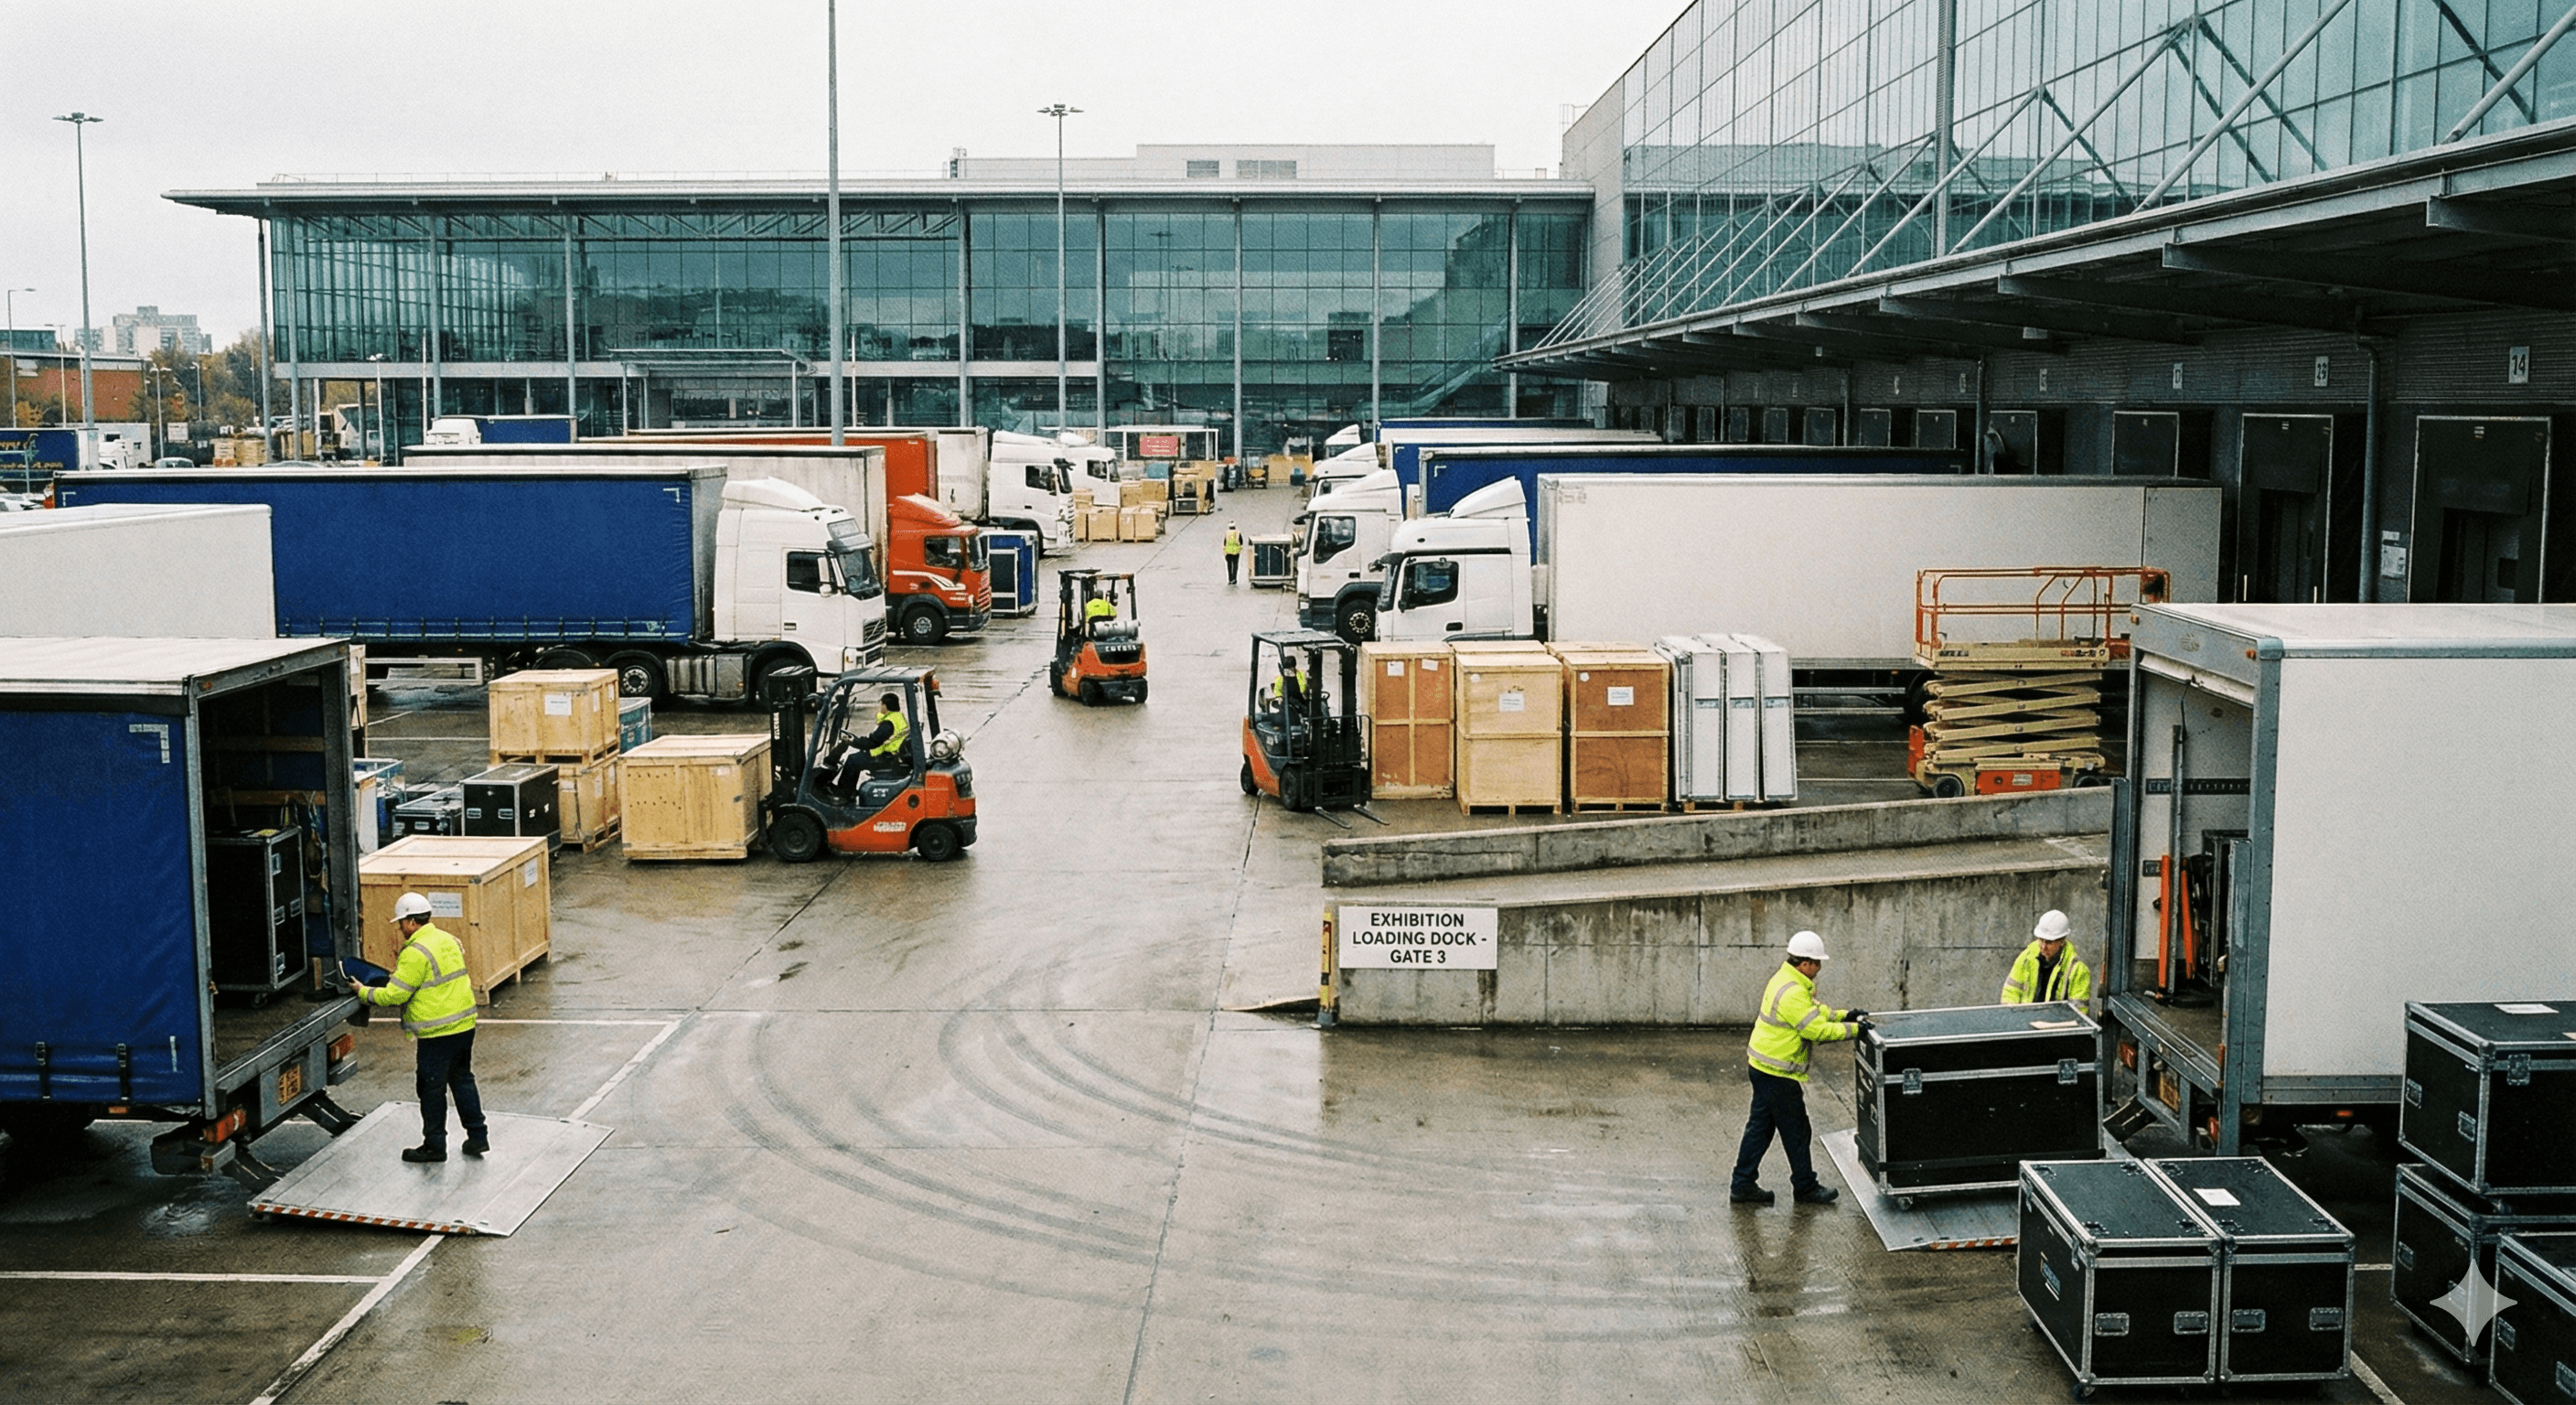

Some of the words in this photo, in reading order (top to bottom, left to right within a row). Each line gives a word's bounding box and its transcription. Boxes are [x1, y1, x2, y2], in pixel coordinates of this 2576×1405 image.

[2512, 354, 2526, 375] 14
[1371, 913, 1464, 927] EXHIBITION
[1353, 931, 1425, 946] LOADING
[1431, 931, 1476, 946] DOCK
[1390, 949, 1433, 963] GATE
[1437, 949, 1446, 963] 3
